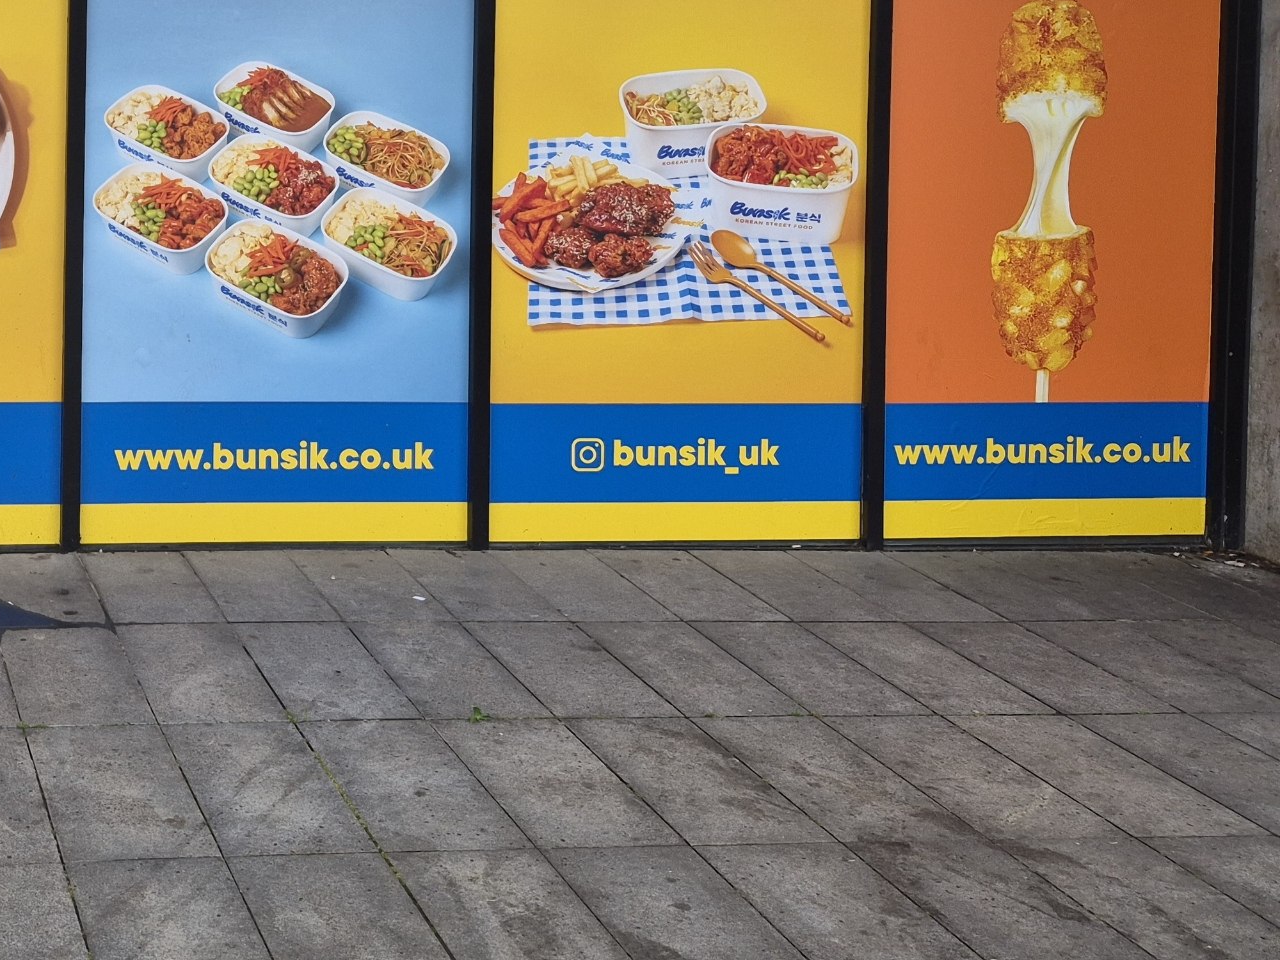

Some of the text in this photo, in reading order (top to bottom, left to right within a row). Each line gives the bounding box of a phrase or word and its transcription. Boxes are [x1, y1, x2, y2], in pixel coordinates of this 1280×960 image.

[729, 200, 791, 222] Bunsik
[735, 218, 763, 226] KOREAN
[114, 441, 435, 472] www.bunsik.co.uk
[613, 437, 780, 475] bunsik_uk
[894, 436, 1191, 465] www.bunsik.co.uk
